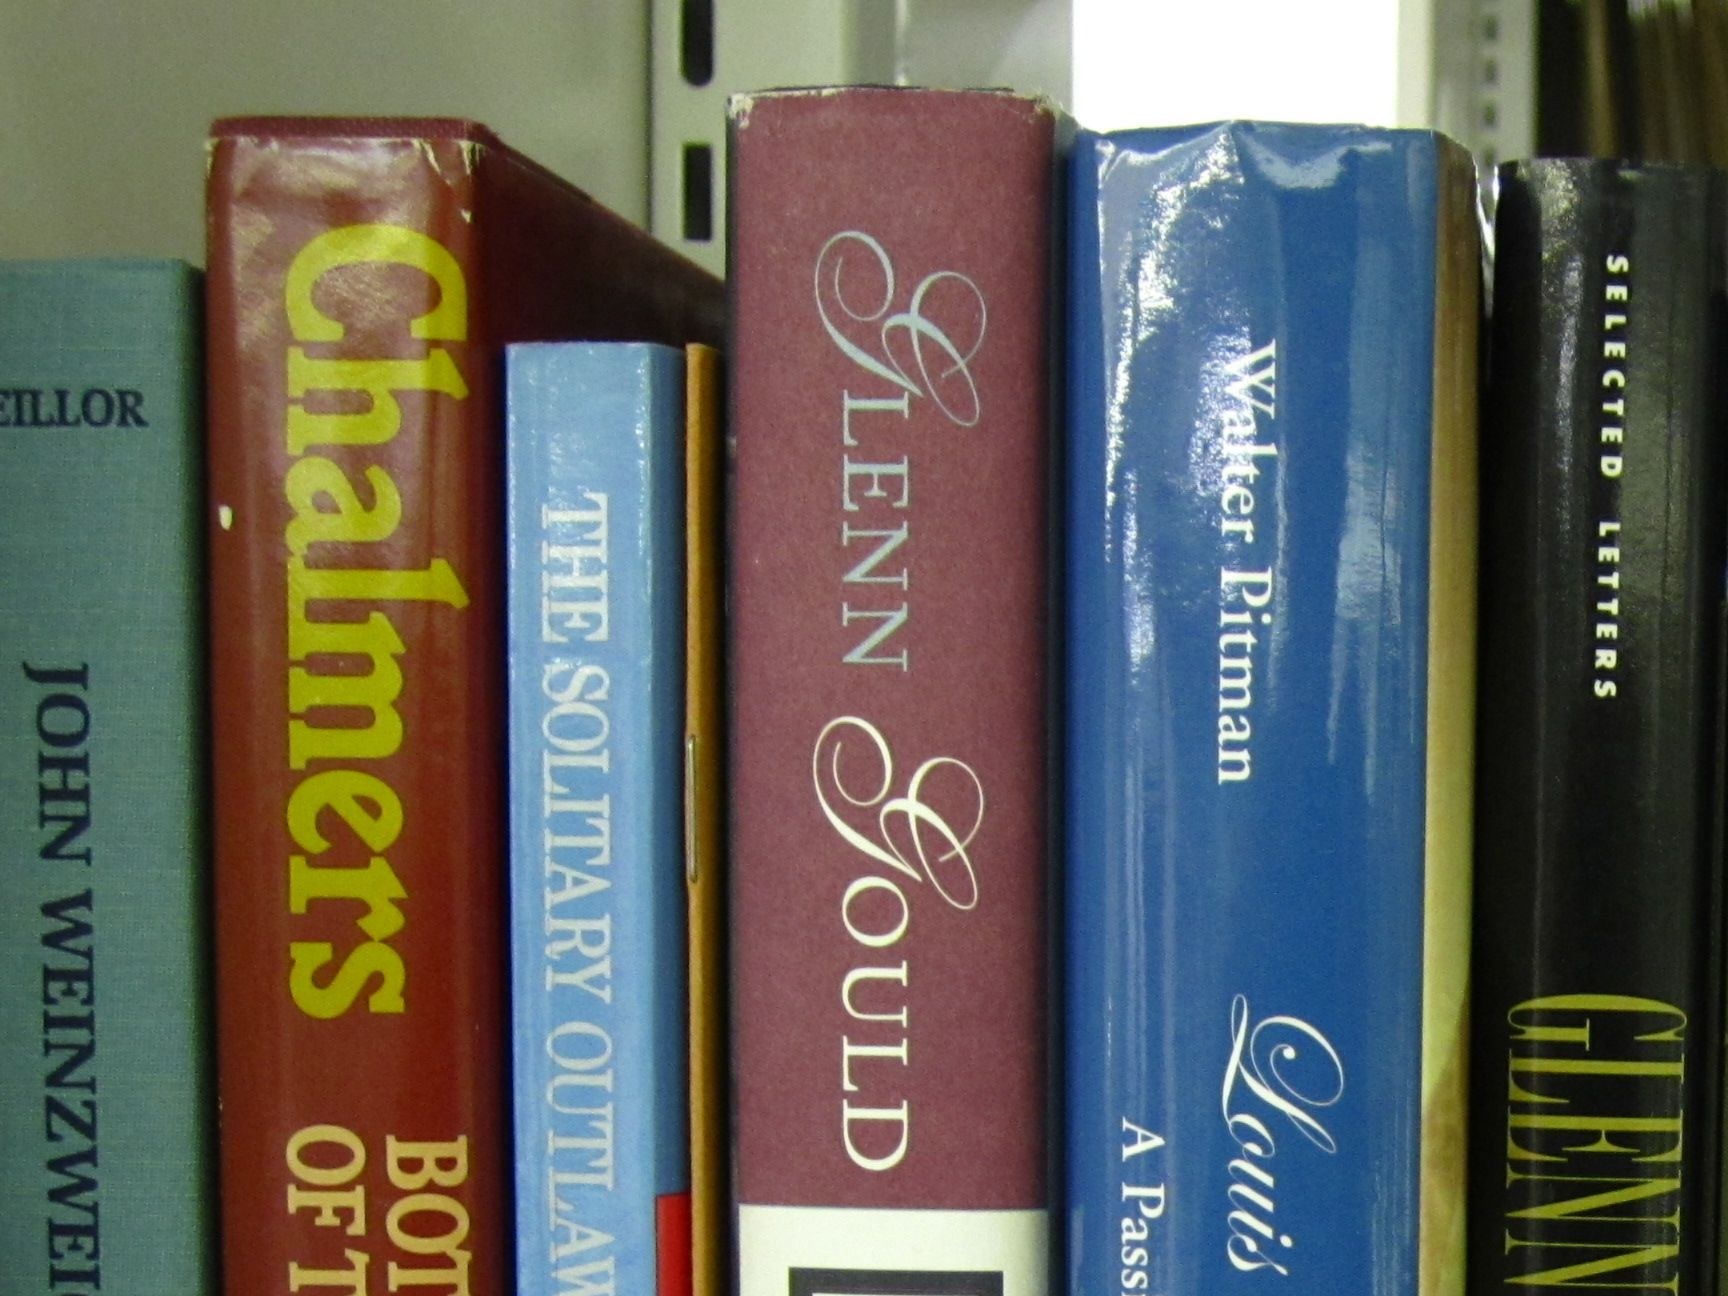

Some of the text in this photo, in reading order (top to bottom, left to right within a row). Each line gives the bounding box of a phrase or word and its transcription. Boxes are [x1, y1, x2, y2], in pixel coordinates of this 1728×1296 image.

[541, 492, 609, 644] THE
[1217, 338, 1278, 786] Walter Pitman
[1594, 253, 1630, 700] SELECTED LETTERS
[22, 661, 93, 865] JOHN
[285, 224, 469, 1018] Chalmers
[541, 666, 613, 1002] SOLITARY
[285, 1124, 367, 1236] OF
[1120, 1117, 1156, 1161] A
[1221, 992, 1345, 1277] Louis
